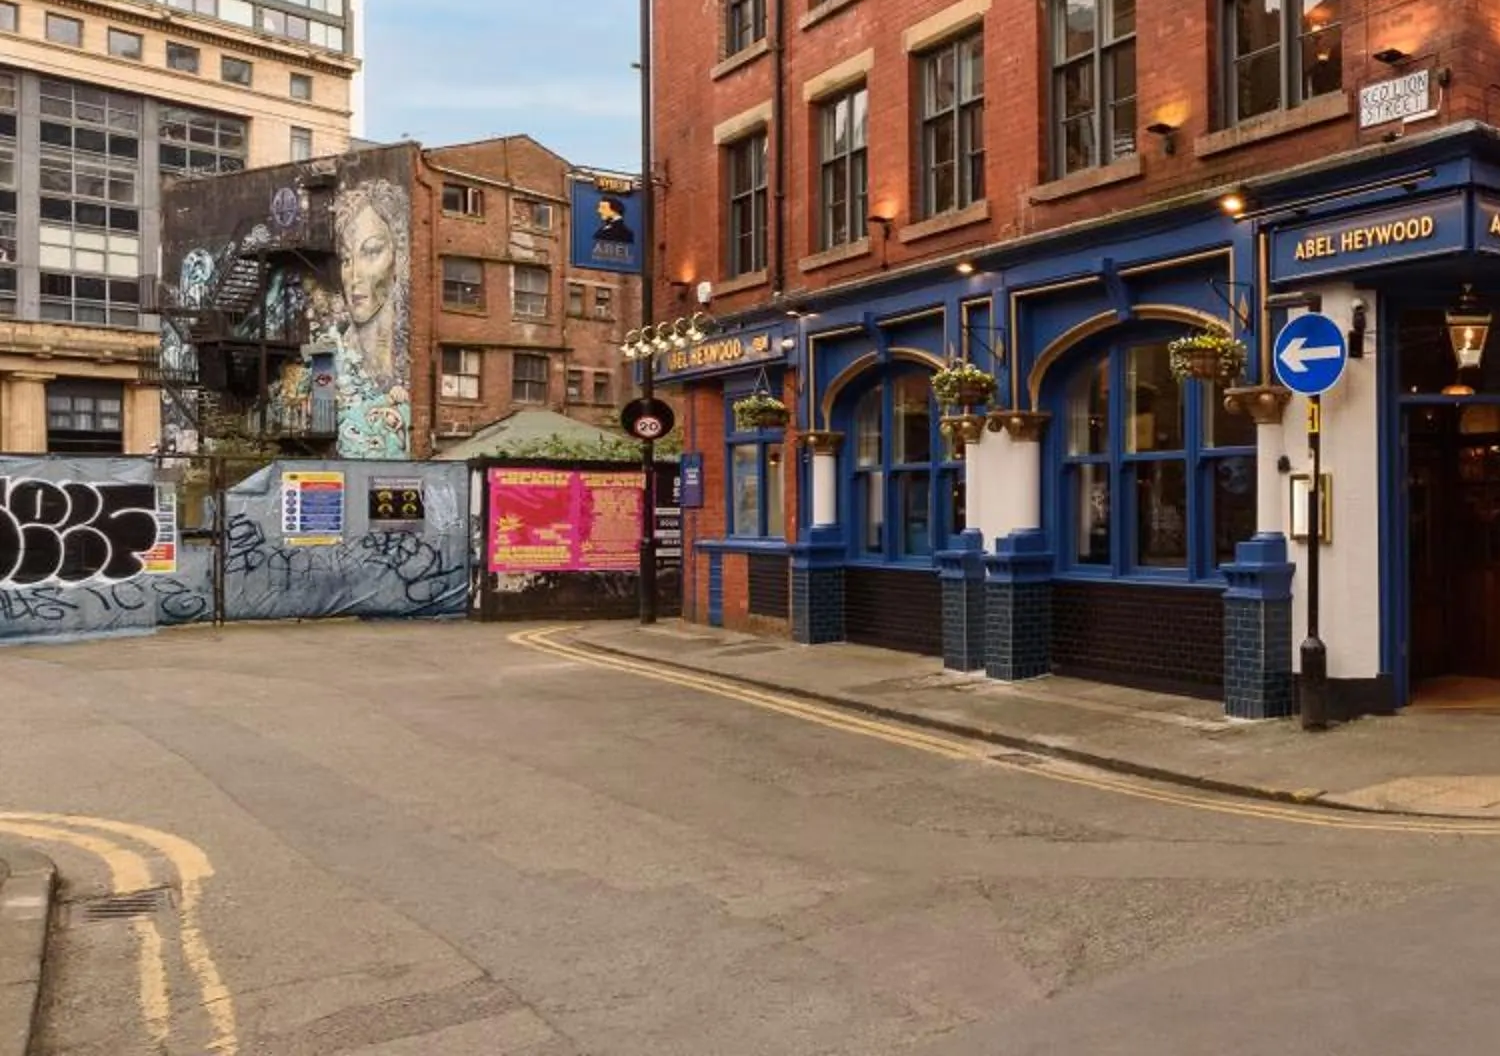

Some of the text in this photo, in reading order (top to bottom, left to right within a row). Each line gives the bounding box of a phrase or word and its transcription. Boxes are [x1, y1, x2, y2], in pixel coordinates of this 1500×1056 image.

[1363, 93, 1420, 123] STREET
[1294, 215, 1433, 260] ABEL HEYWOOD
[639, 422, 658, 432] 20
